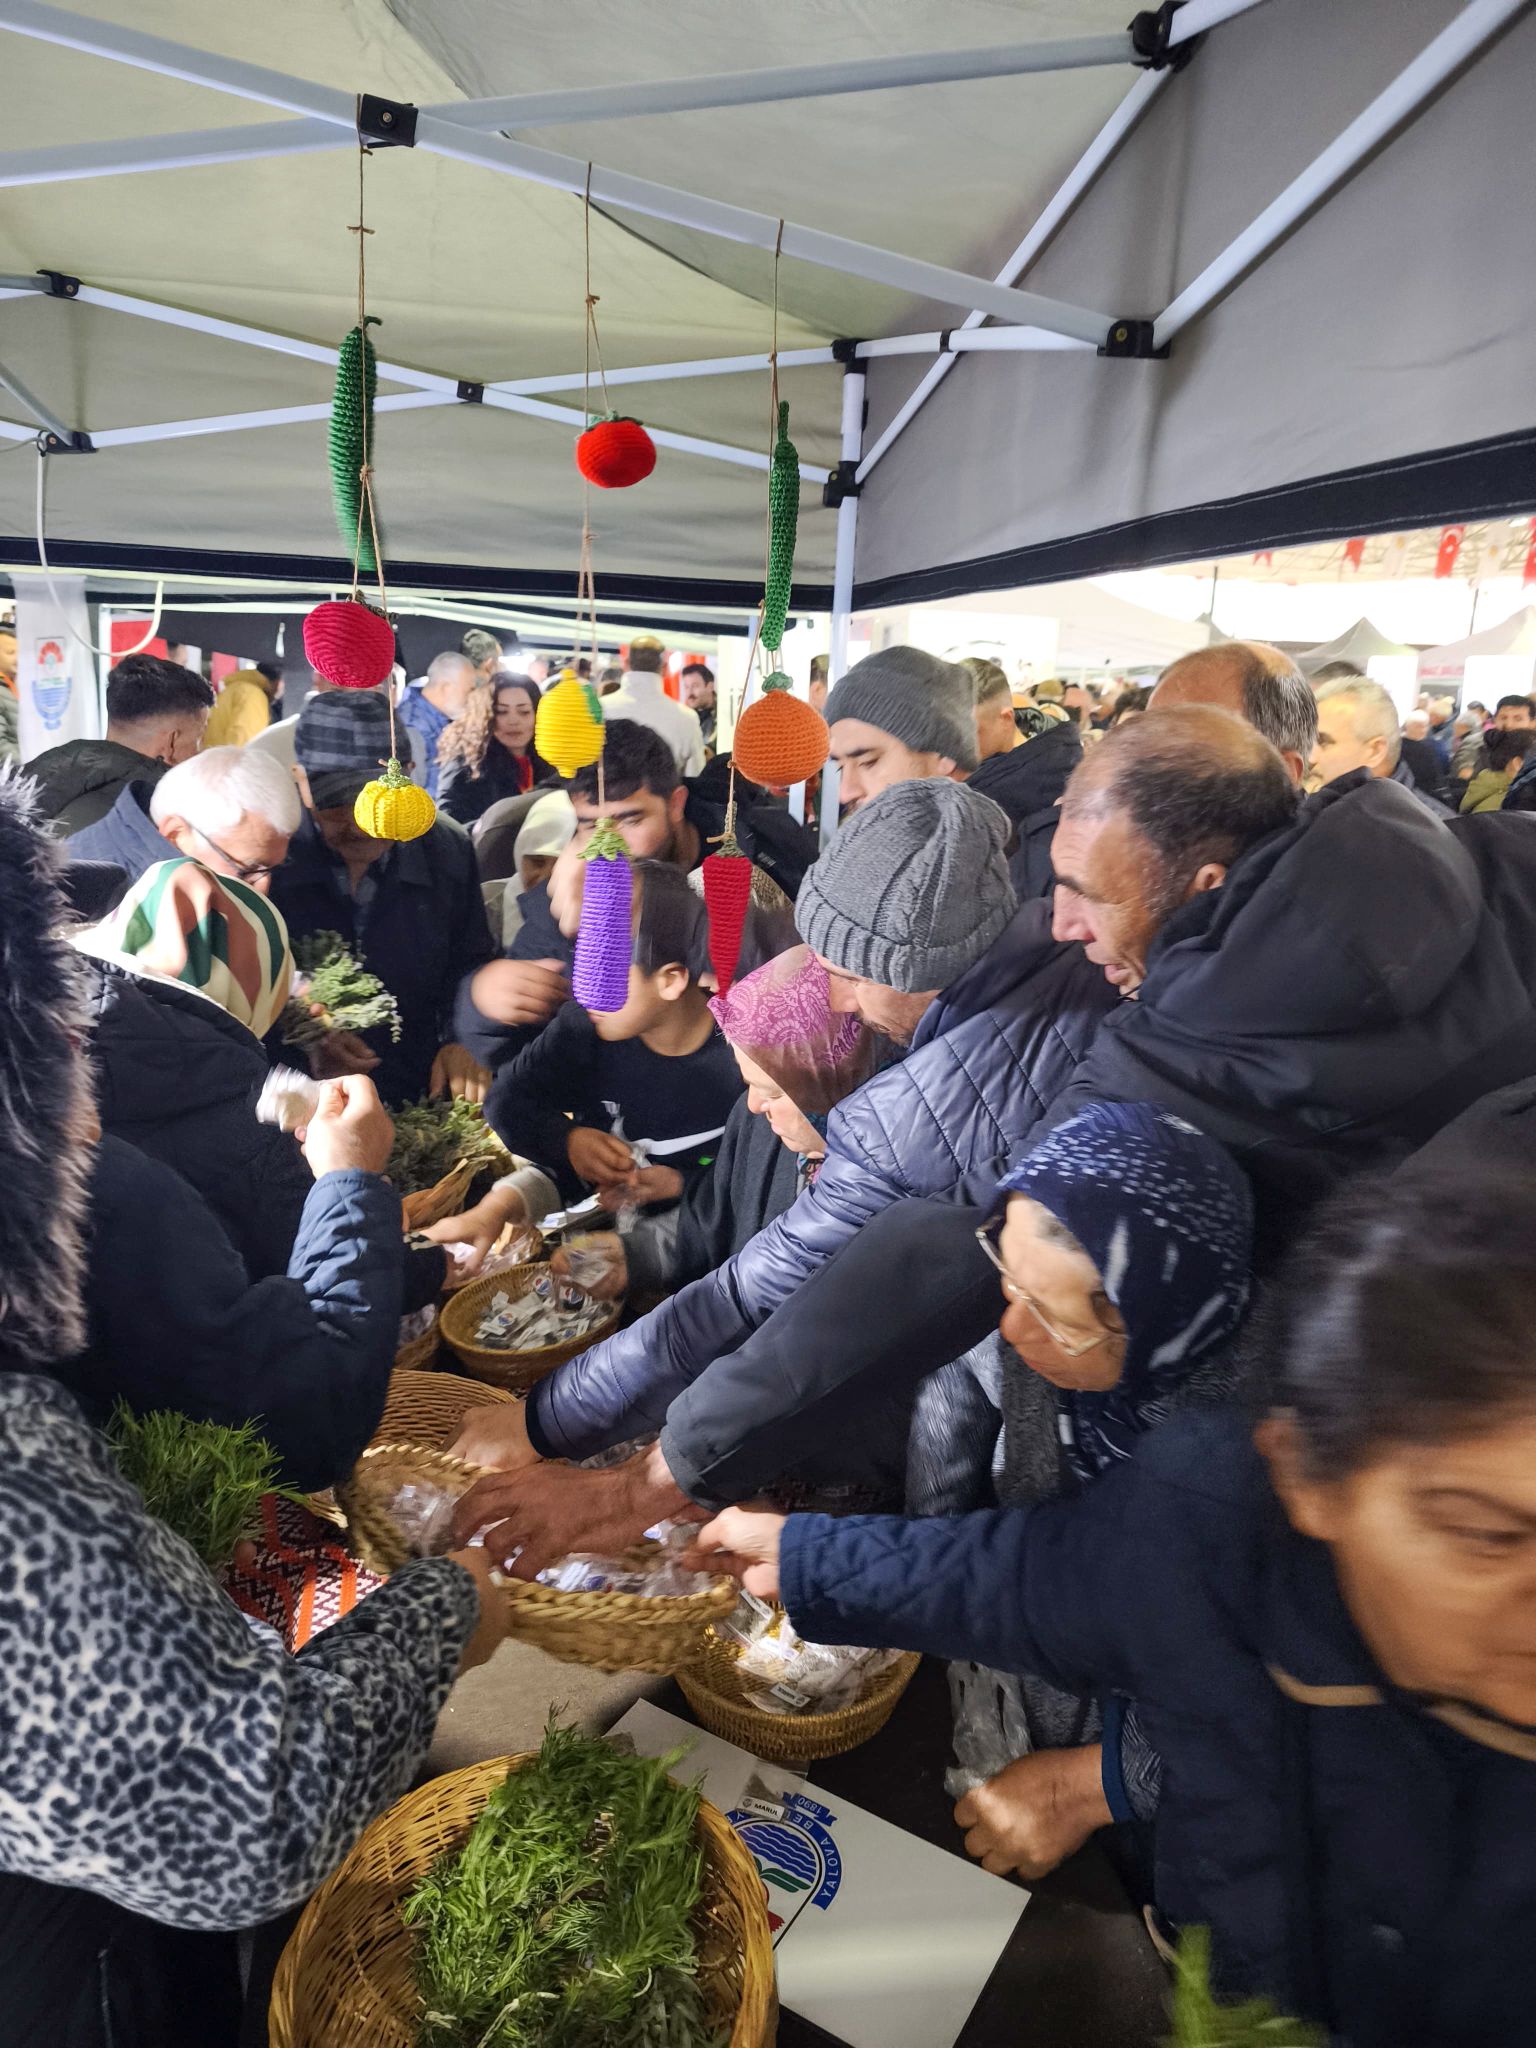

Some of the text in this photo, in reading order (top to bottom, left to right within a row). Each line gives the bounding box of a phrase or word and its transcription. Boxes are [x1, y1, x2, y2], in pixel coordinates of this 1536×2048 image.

[754, 1803, 778, 1816] MARUL
[797, 1797, 822, 1814] 1890
[820, 1836, 839, 1897] YALOVA
